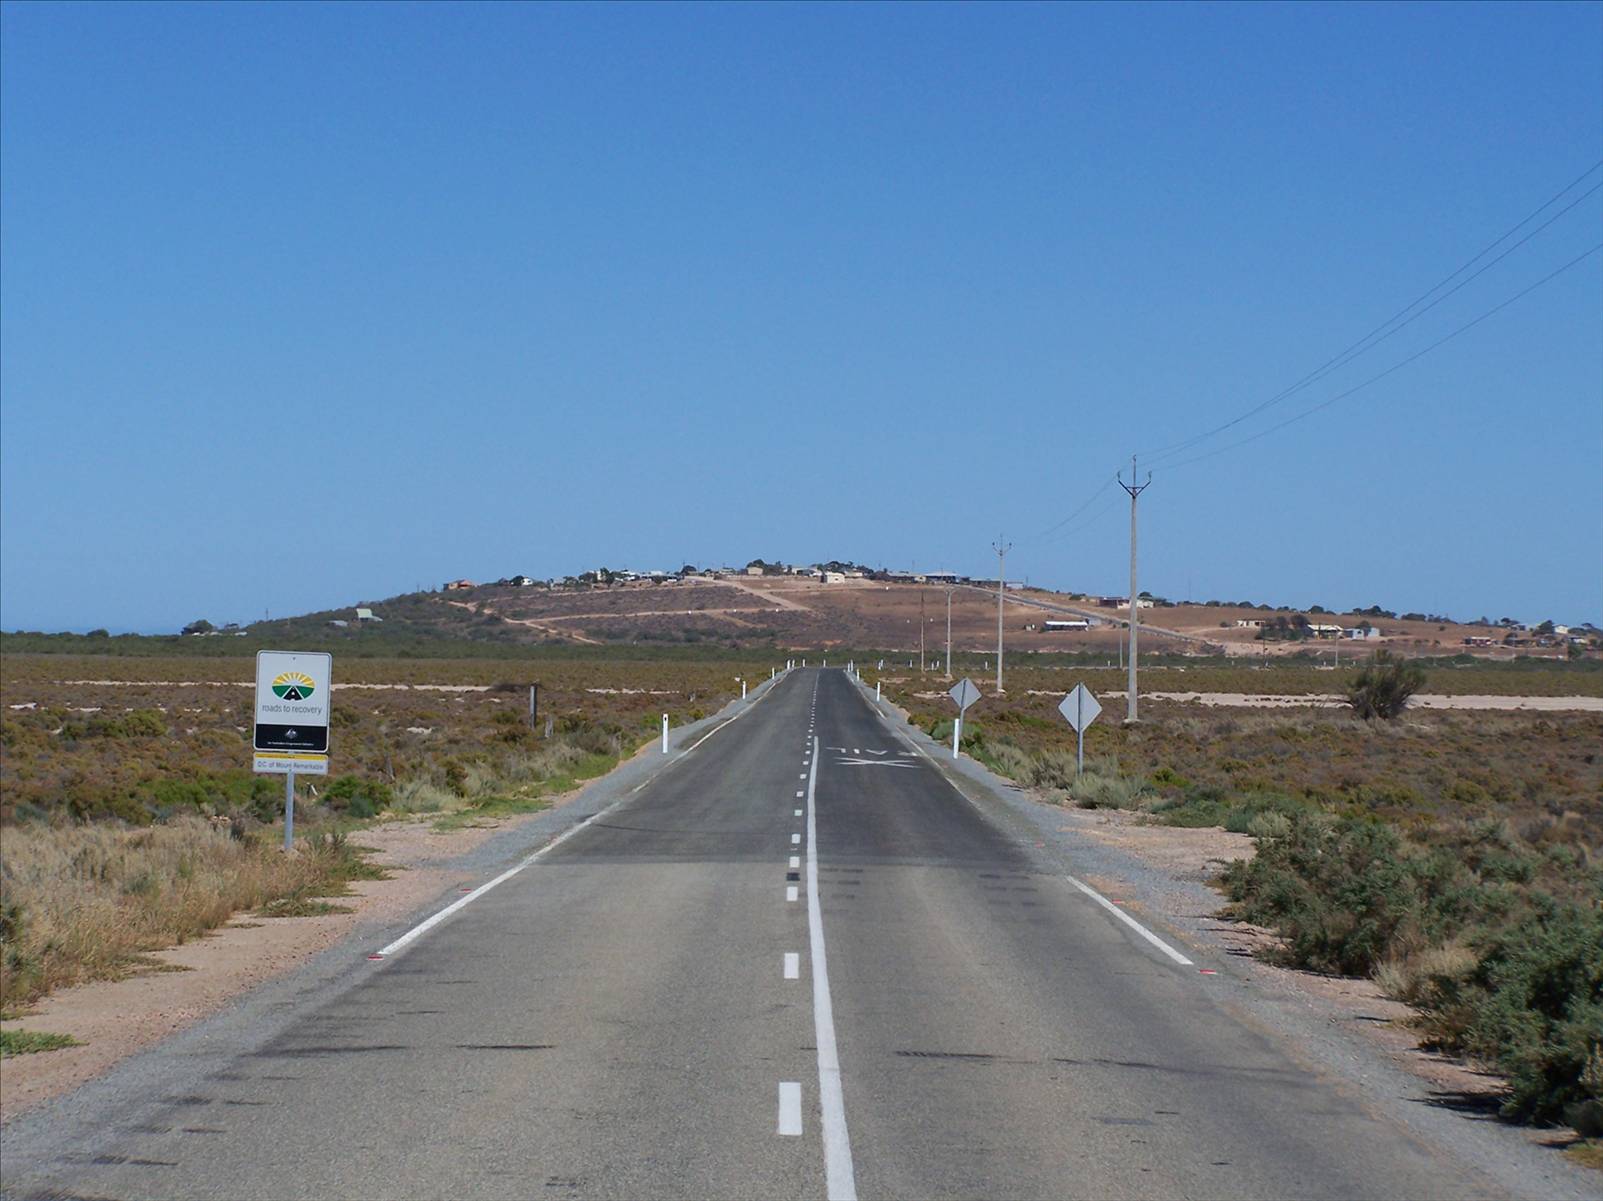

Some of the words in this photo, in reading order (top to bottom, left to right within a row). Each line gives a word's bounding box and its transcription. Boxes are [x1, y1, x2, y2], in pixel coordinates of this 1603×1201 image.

[262, 704, 282, 713] roads
[283, 705, 291, 713] to
[292, 706, 323, 715] recovery
